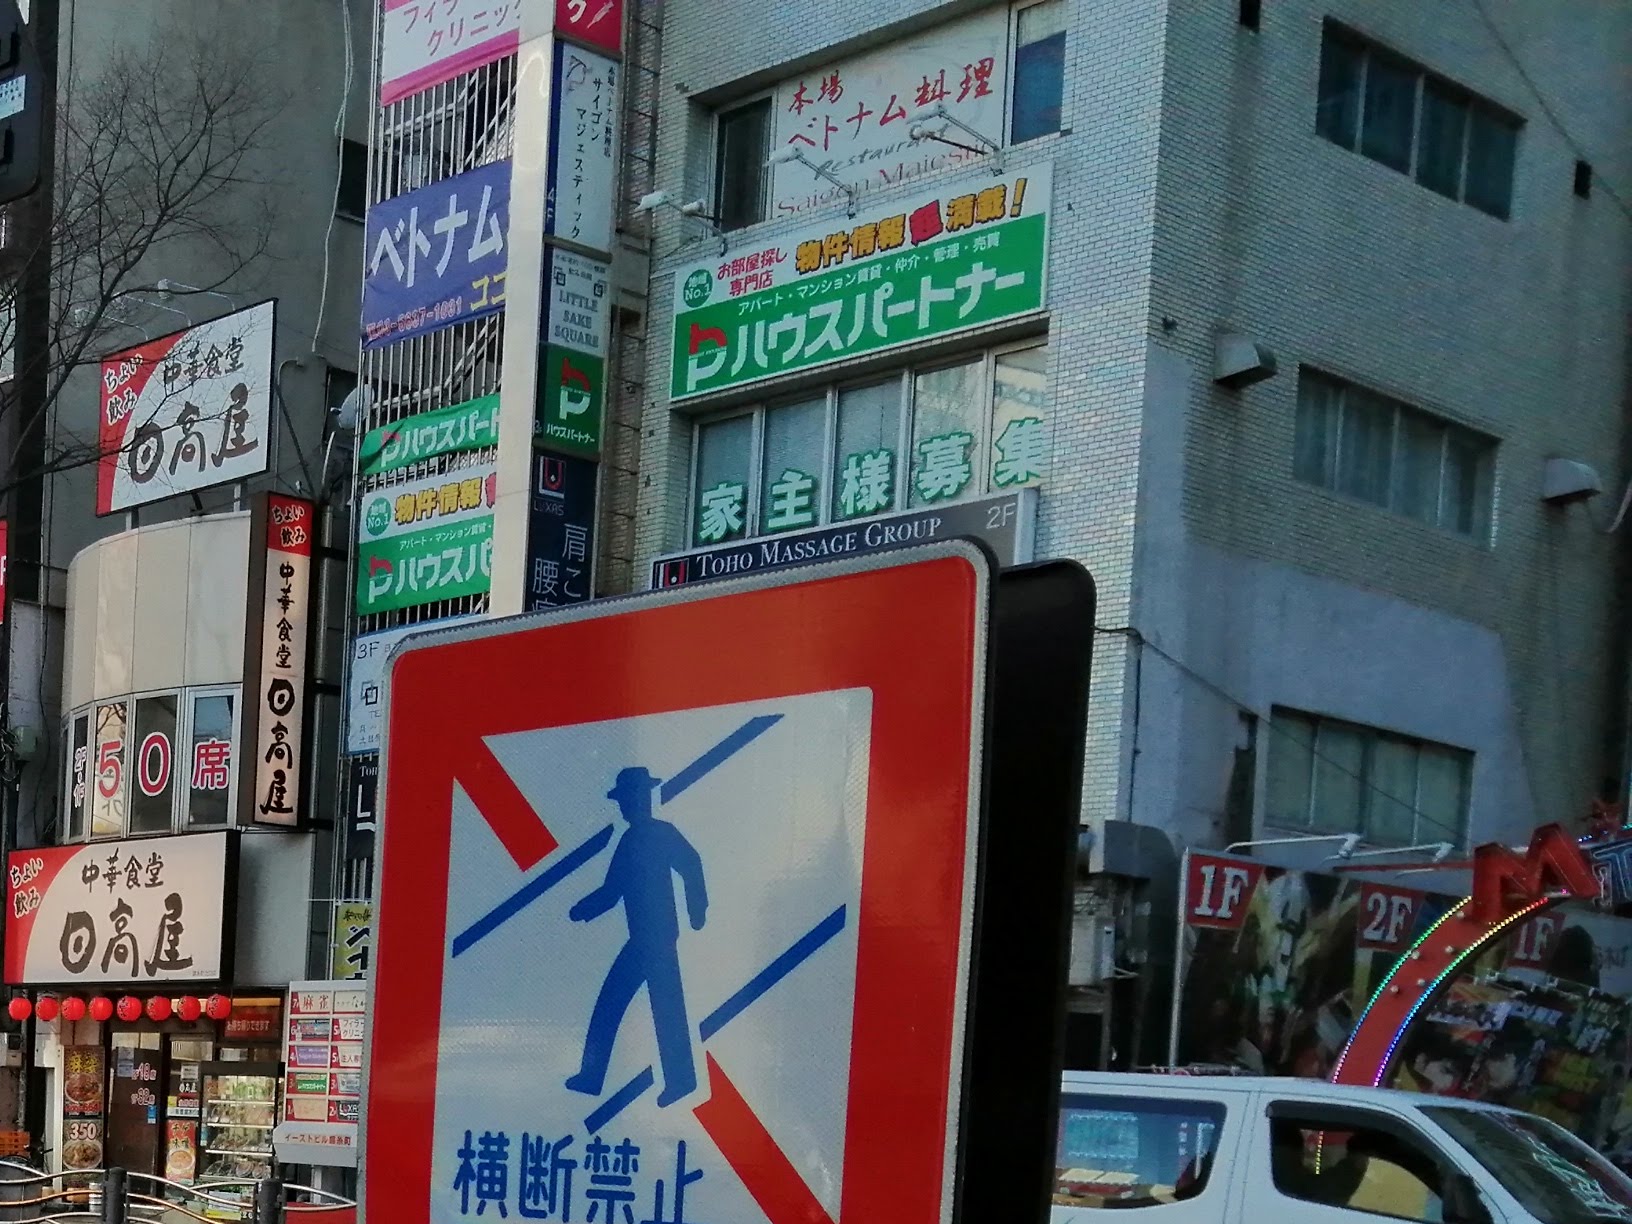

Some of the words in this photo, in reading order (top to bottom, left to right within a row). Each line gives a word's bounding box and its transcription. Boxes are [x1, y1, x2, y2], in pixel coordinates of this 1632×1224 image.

[788, 69, 844, 116] 本場
[370, 183, 505, 288] ベトナム
[717, 247, 788, 280] お部屋探し
[729, 268, 774, 296] 専門店
[554, 324, 600, 348] SQUARE
[562, 309, 593, 329] SAKE
[730, 259, 1026, 377] ハウスパートナー
[162, 334, 246, 392] 中華食堂
[127, 381, 260, 485] 日高屋
[697, 414, 1045, 543] 家主様募集
[695, 544, 754, 578] TOHO
[758, 530, 858, 565] MASSAGE
[863, 515, 943, 549] GROUP
[986, 501, 1016, 531] 2F
[276, 561, 296, 670] 中華食堂
[356, 640, 380, 658] 3F
[259, 677, 297, 815] 日高屋
[9, 856, 44, 889] ちょい
[81, 847, 165, 894] 中華食堂
[1193, 864, 1249, 920] 1F
[14, 891, 42, 919] 飲み
[1362, 891, 1413, 944] 2F
[59, 892, 194, 978] 日高屋
[69, 1122, 97, 1141] 350
